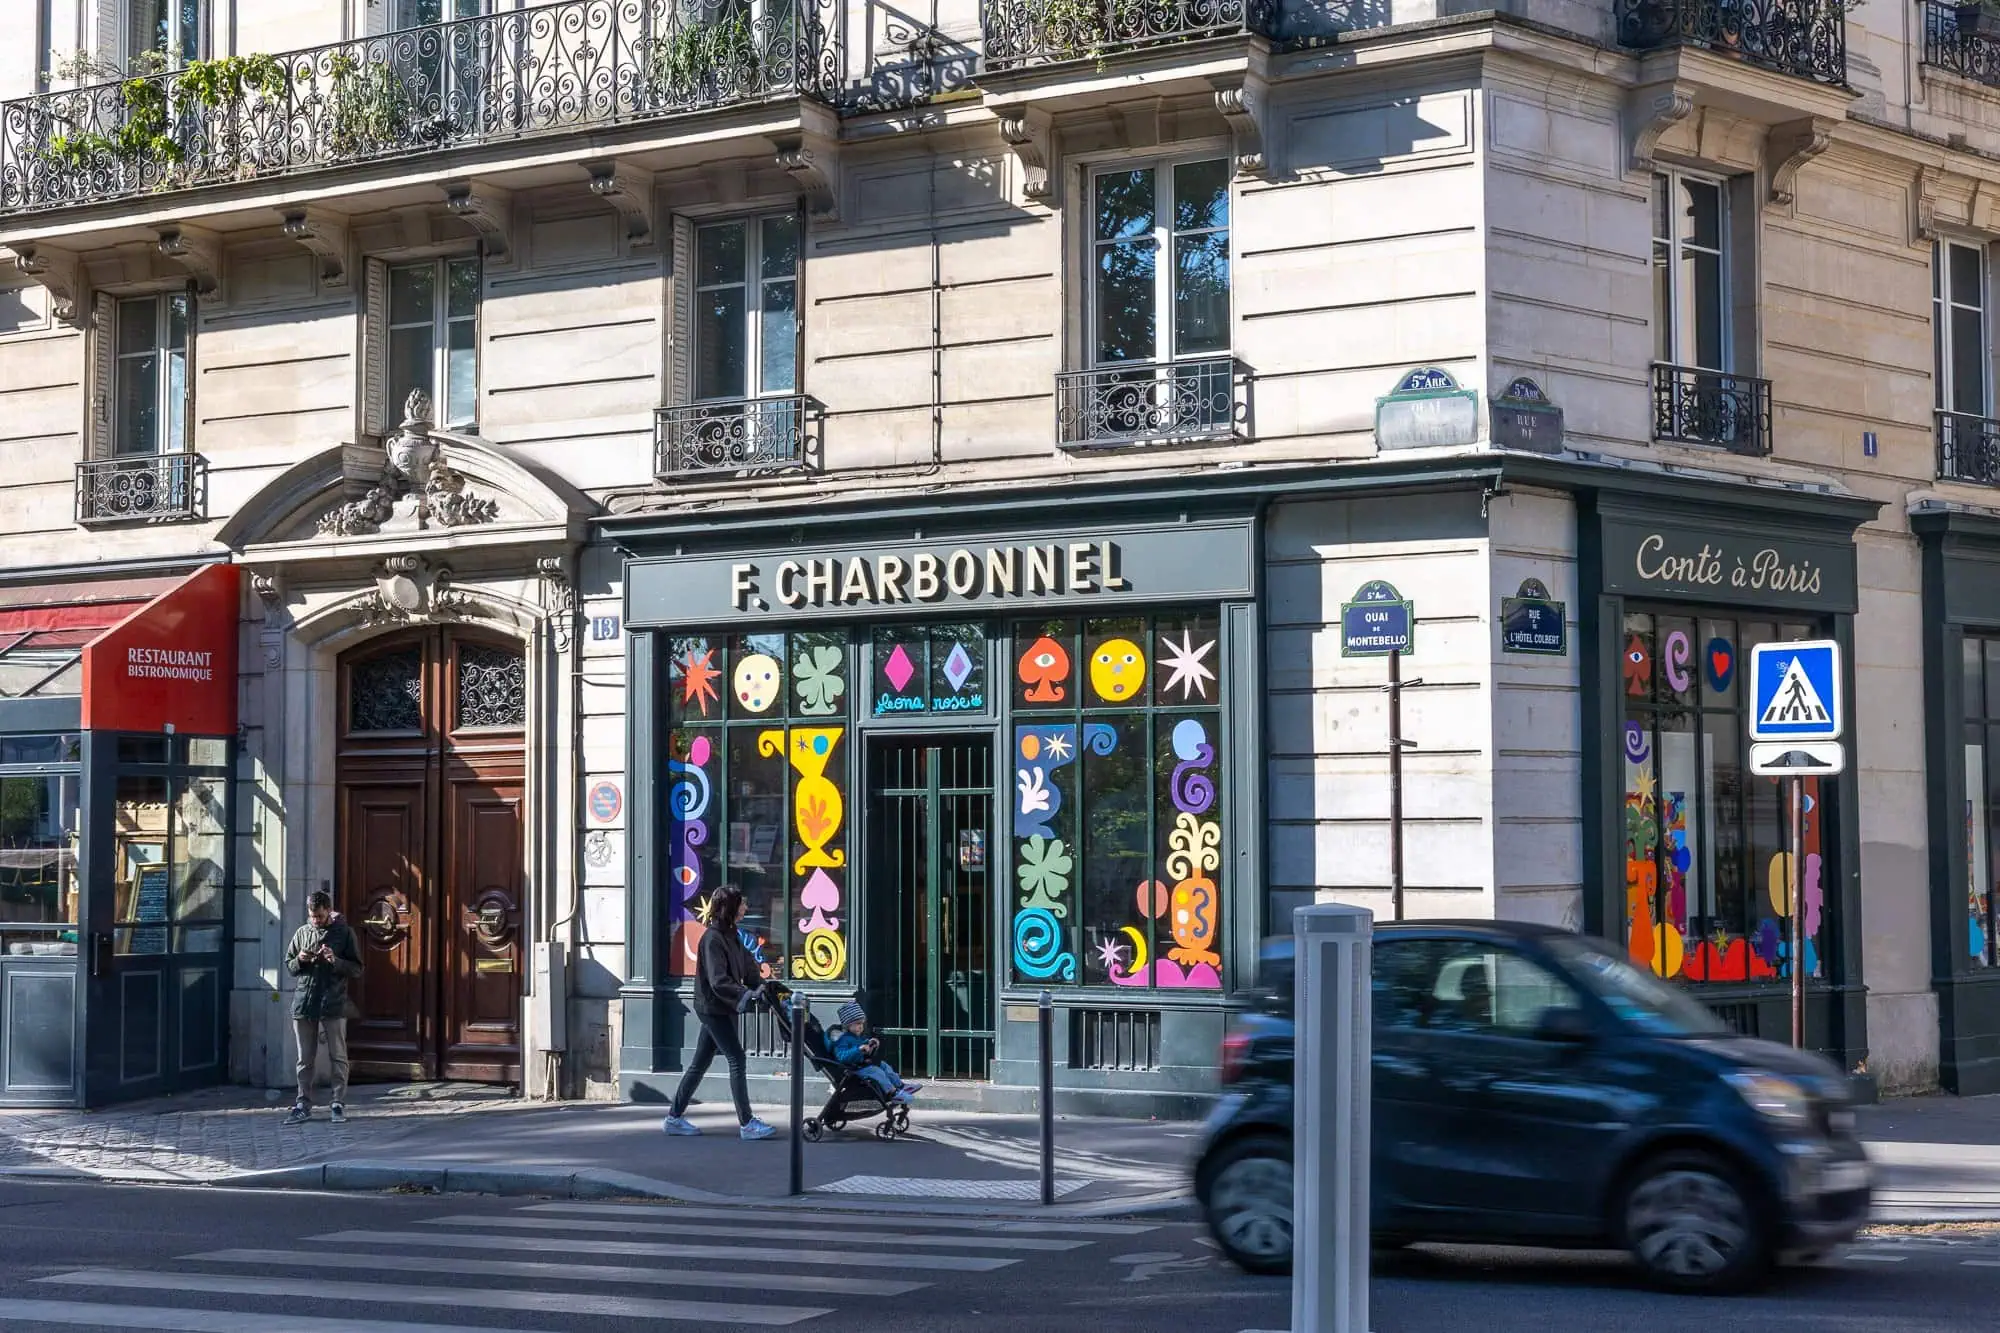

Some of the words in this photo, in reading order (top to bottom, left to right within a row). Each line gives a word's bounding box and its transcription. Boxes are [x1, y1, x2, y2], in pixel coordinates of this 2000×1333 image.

[1636, 534, 1723, 585] Conté
[1731, 556, 1748, 587] à
[1750, 549, 1821, 594] Paris
[731, 563, 761, 608] F.
[775, 540, 1125, 606] CHARBONNEL
[1365, 612, 1389, 623] QUAI
[1528, 609, 1541, 619] RUE
[597, 618, 614, 639] 13
[1347, 635, 1407, 647] MONTEBELLO
[1510, 631, 1533, 643] L'HÔTEL
[1534, 634, 1560, 644] COLBERT
[128, 647, 212, 667] RESTAURANT
[128, 665, 212, 682] BISTRONOMIQUE
[932, 695, 970, 711] rose
